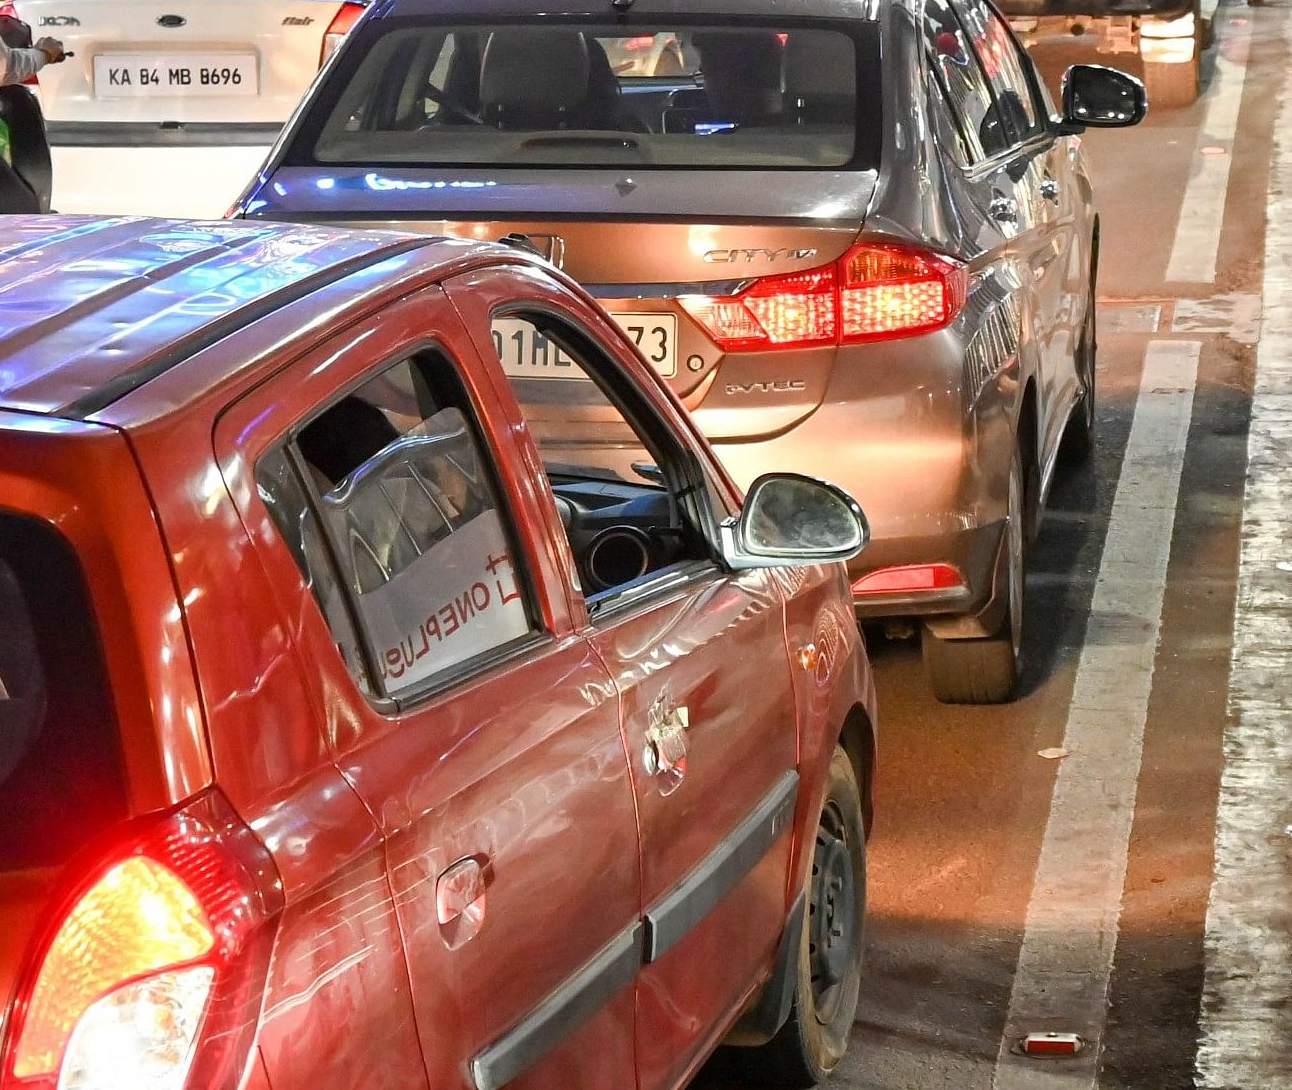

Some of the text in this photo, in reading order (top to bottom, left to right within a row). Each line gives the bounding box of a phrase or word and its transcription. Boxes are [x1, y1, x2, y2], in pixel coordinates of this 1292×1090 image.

[109, 68, 132, 85] KA
[168, 68, 192, 85] MB
[704, 247, 788, 264] CITY
